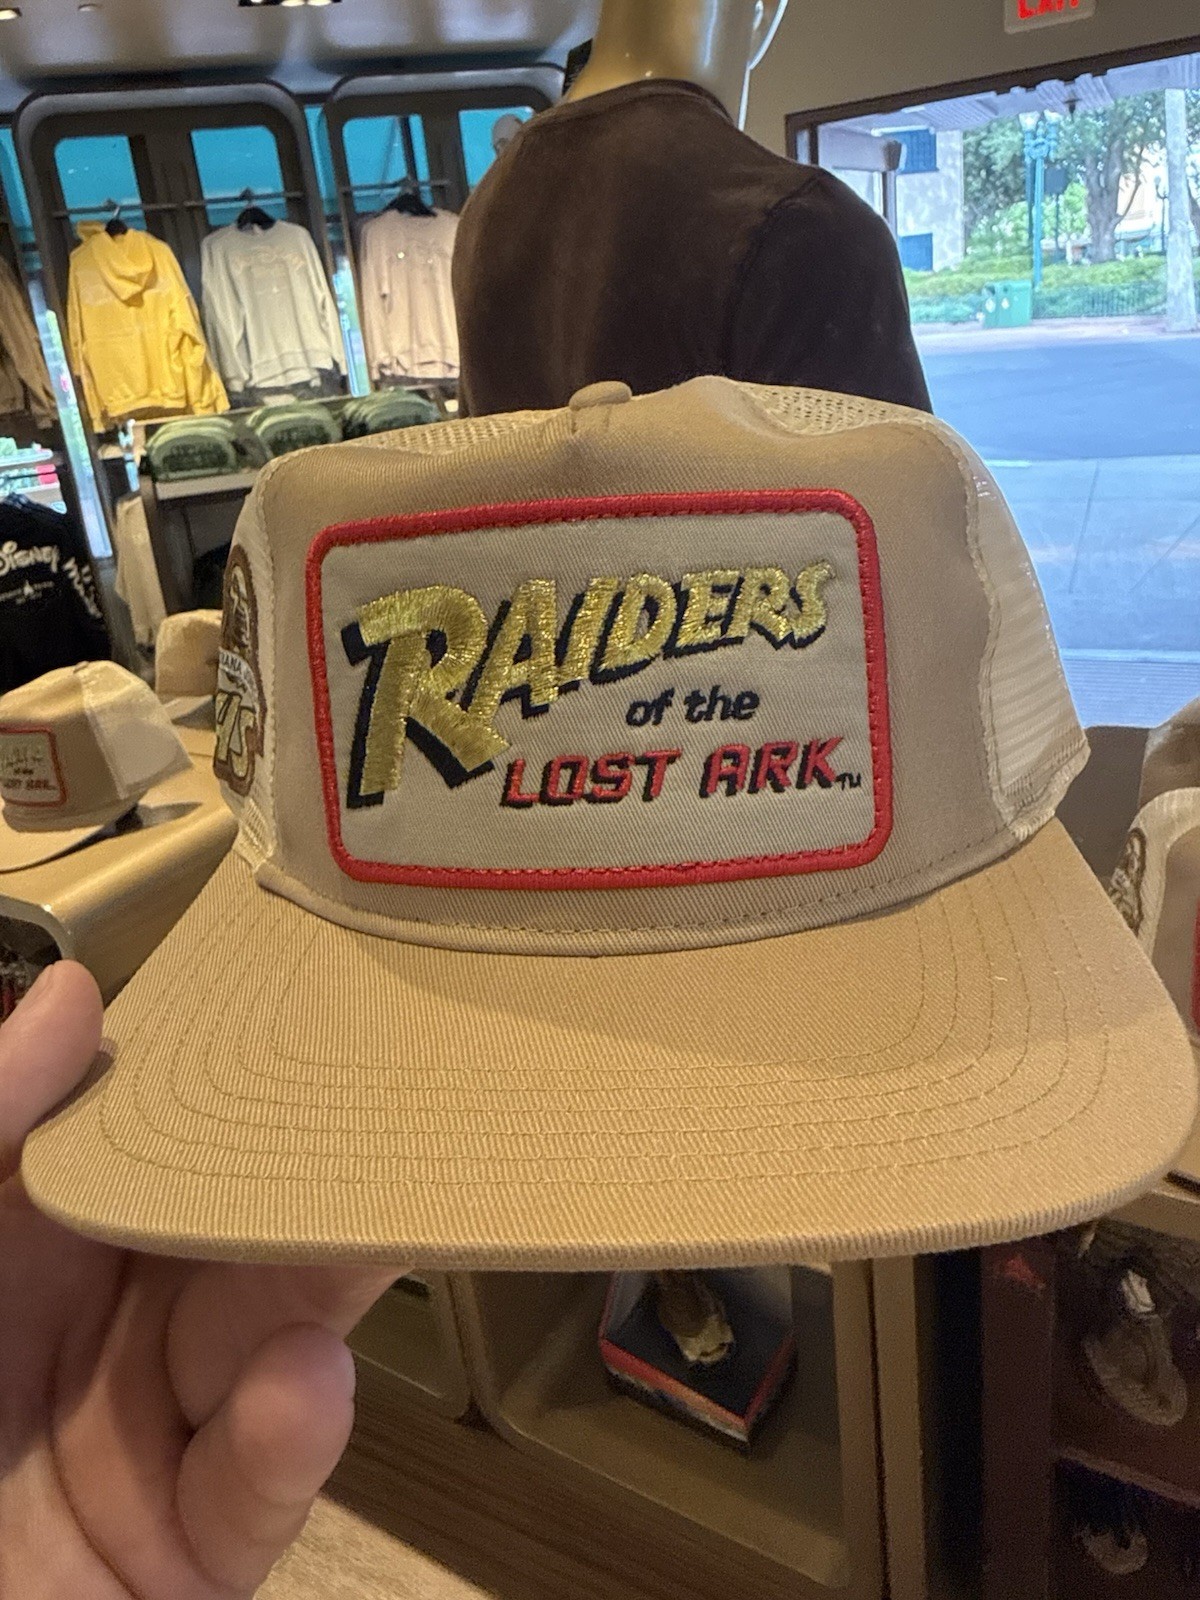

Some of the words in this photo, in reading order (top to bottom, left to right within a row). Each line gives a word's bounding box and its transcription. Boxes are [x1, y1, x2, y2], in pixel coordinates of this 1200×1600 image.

[340, 560, 836, 809] RAIDERS
[625, 687, 675, 727] of
[683, 684, 760, 723] the
[499, 747, 680, 808] LOST
[700, 736, 844, 799] ARK
